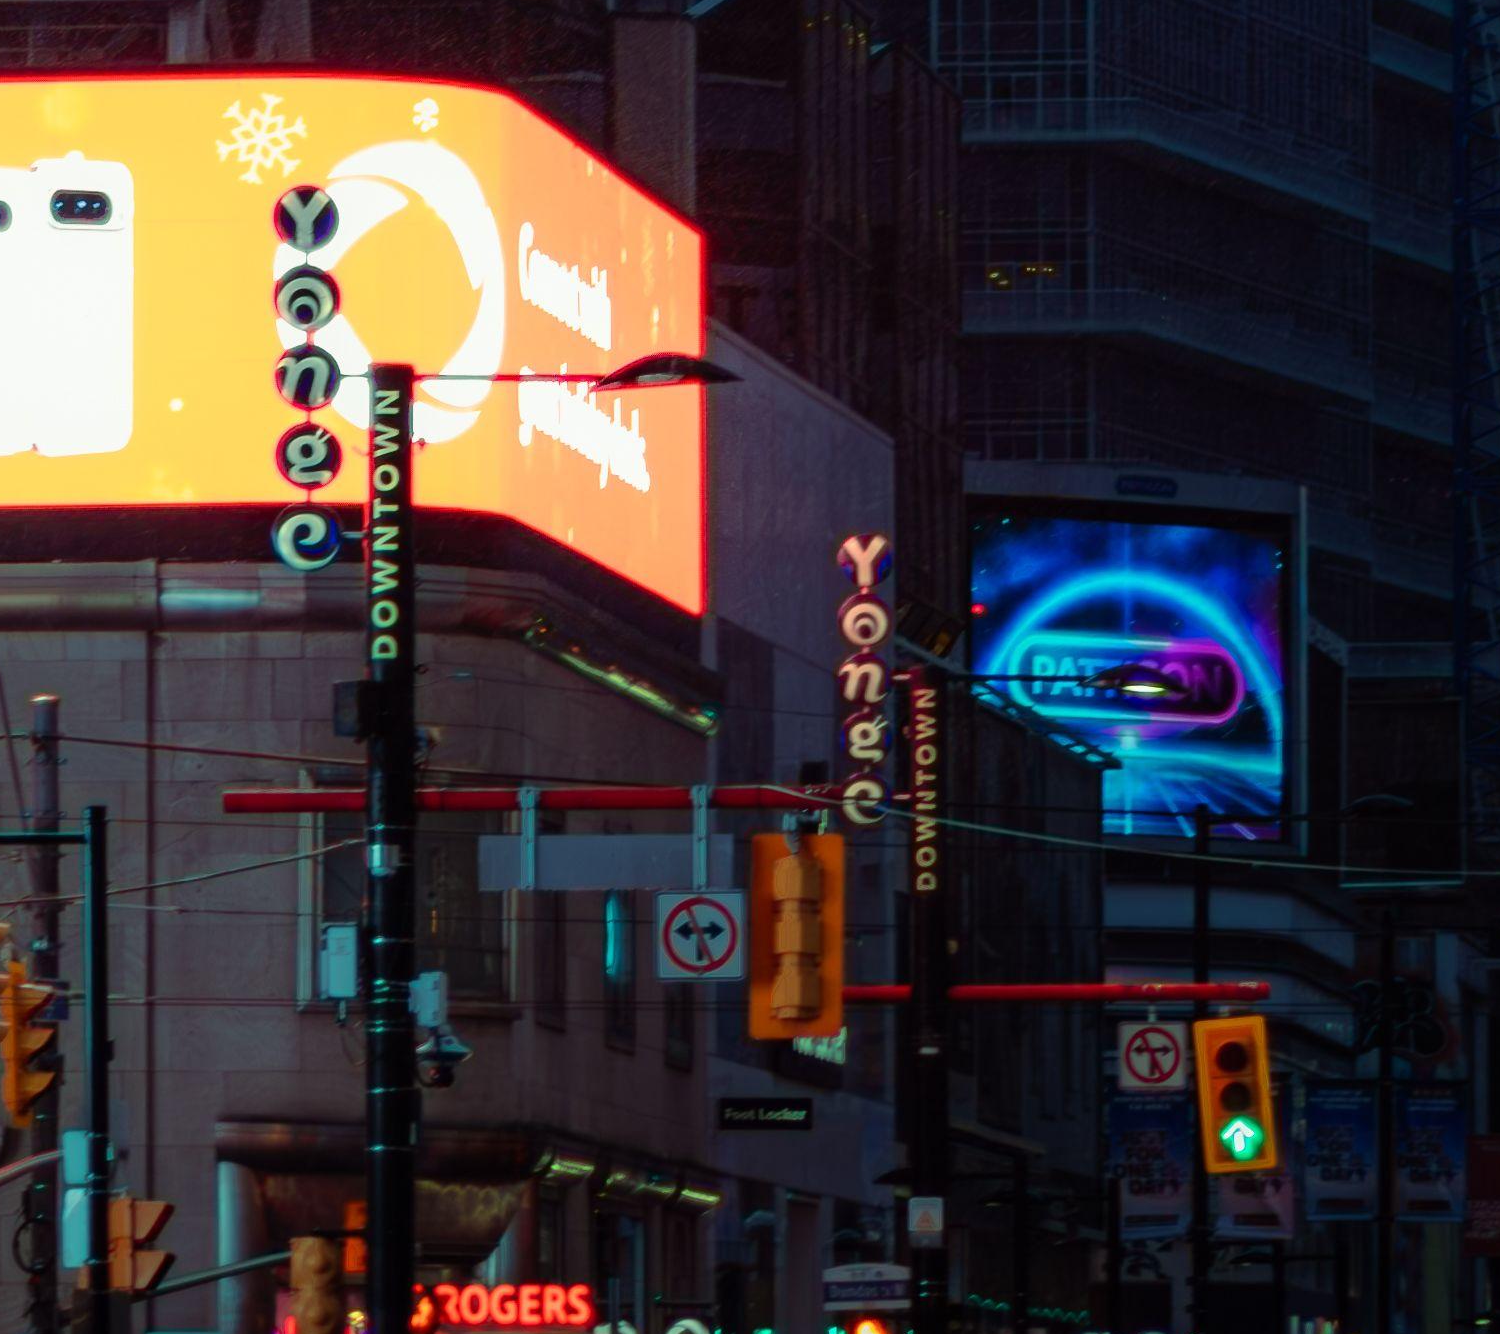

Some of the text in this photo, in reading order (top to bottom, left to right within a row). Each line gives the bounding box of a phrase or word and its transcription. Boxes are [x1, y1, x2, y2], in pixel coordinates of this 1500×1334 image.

[371, 387, 401, 660] DOWNTOWN
[837, 533, 893, 827] Yonge
[915, 686, 938, 892] DOWNTOWN
